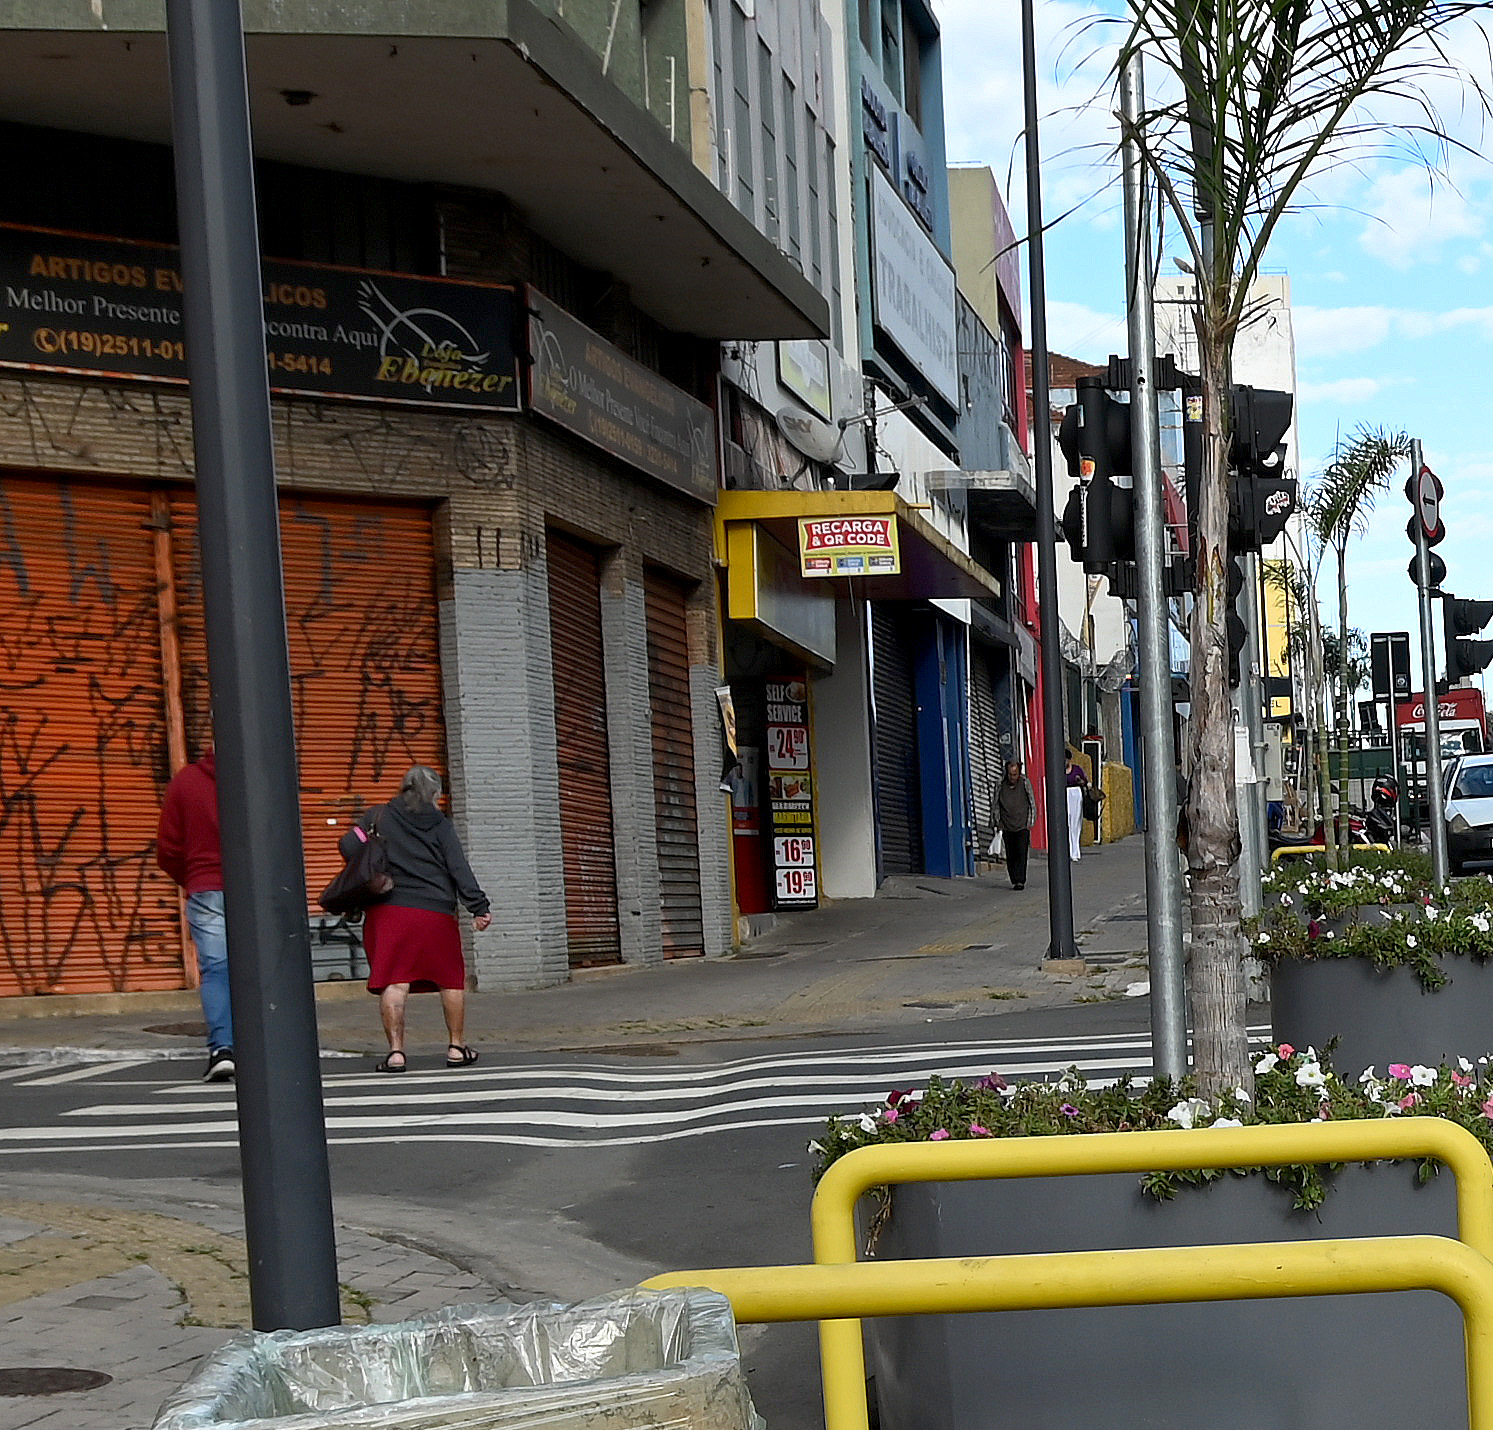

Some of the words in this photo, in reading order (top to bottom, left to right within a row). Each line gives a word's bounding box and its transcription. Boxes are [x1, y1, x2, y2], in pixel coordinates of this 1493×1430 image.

[31, 255, 147, 288] ARTIGOS
[6, 286, 87, 317] Melhor
[93, 296, 181, 326] Presente
[264, 320, 328, 342] contra
[333, 324, 379, 350] Aqui
[60, 329, 185, 361] (19)2511-01
[811, 521, 884, 535] RECARGA
[812, 536, 821, 546] &
[824, 534, 844, 545] QR
[847, 533, 885, 544] CODE
[766, 684, 785, 702] SELF
[767, 704, 803, 722] SERVICE
